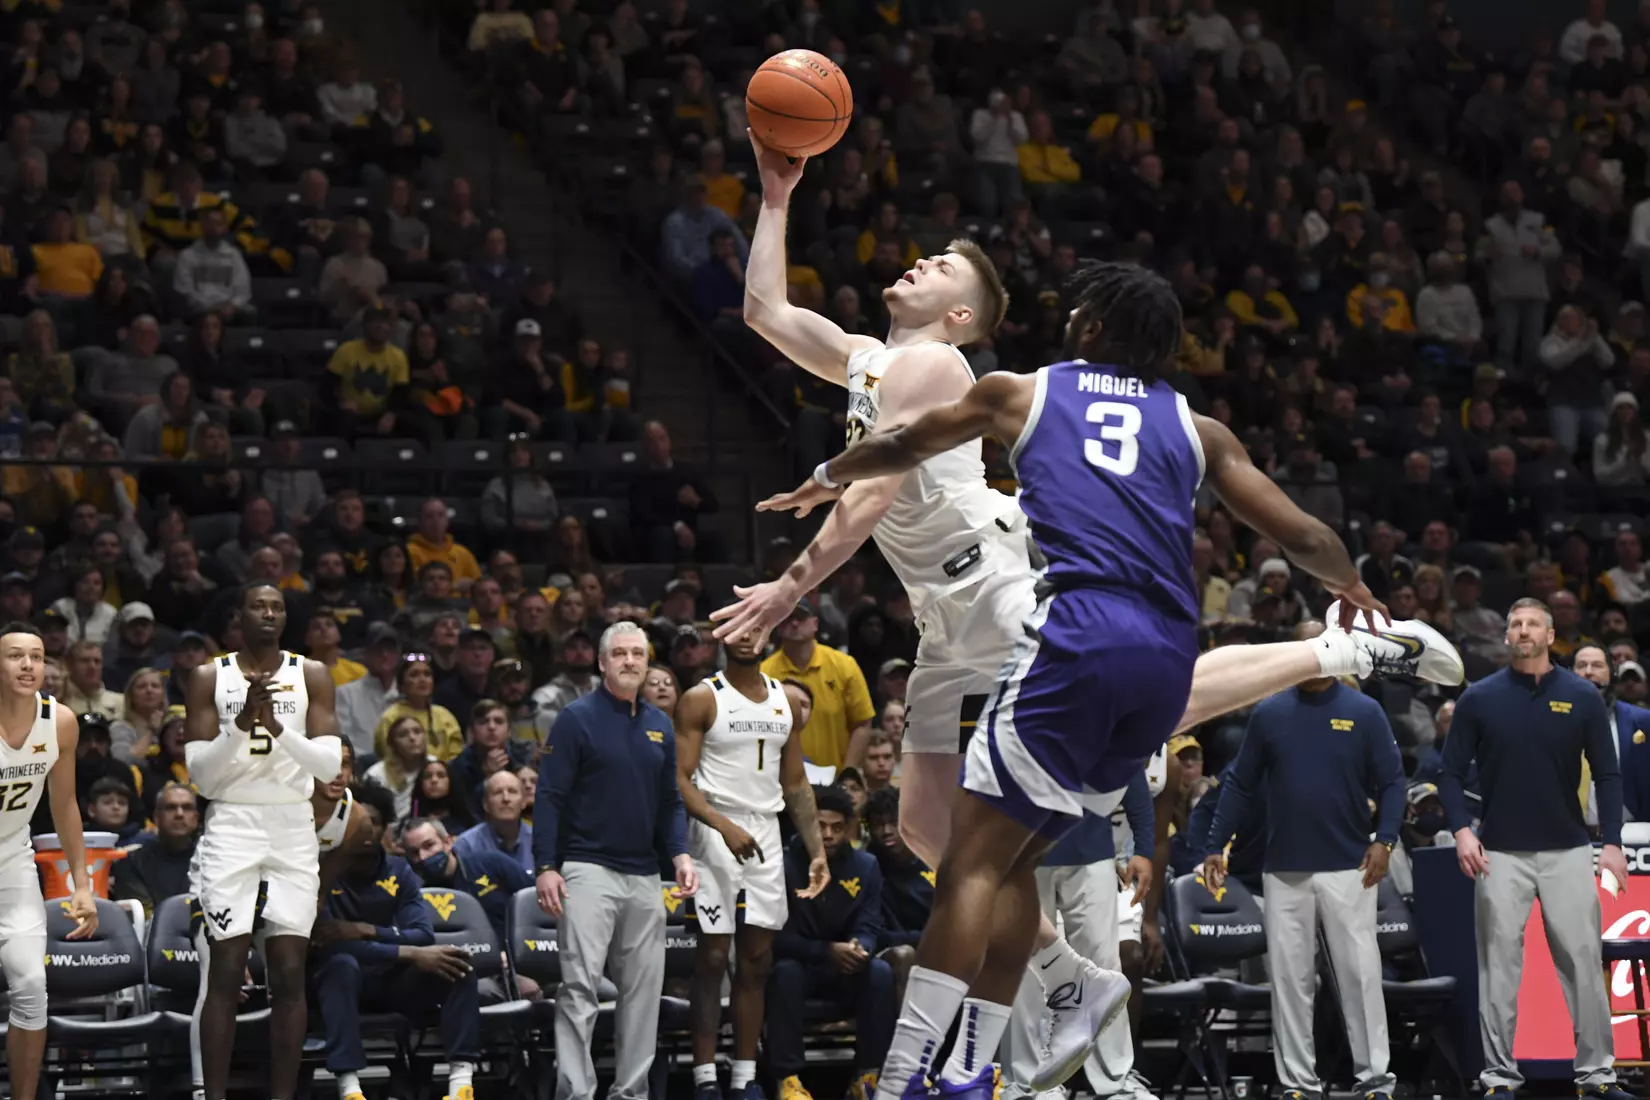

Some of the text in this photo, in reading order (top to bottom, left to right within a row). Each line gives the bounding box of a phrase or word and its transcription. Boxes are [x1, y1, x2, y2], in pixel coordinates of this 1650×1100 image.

[1077, 372, 1149, 399] MIGUEL
[1084, 401, 1143, 477] 3
[249, 722, 273, 756] 5
[729, 720, 788, 735] MOUNTAINEERS
[757, 738, 766, 771] 1
